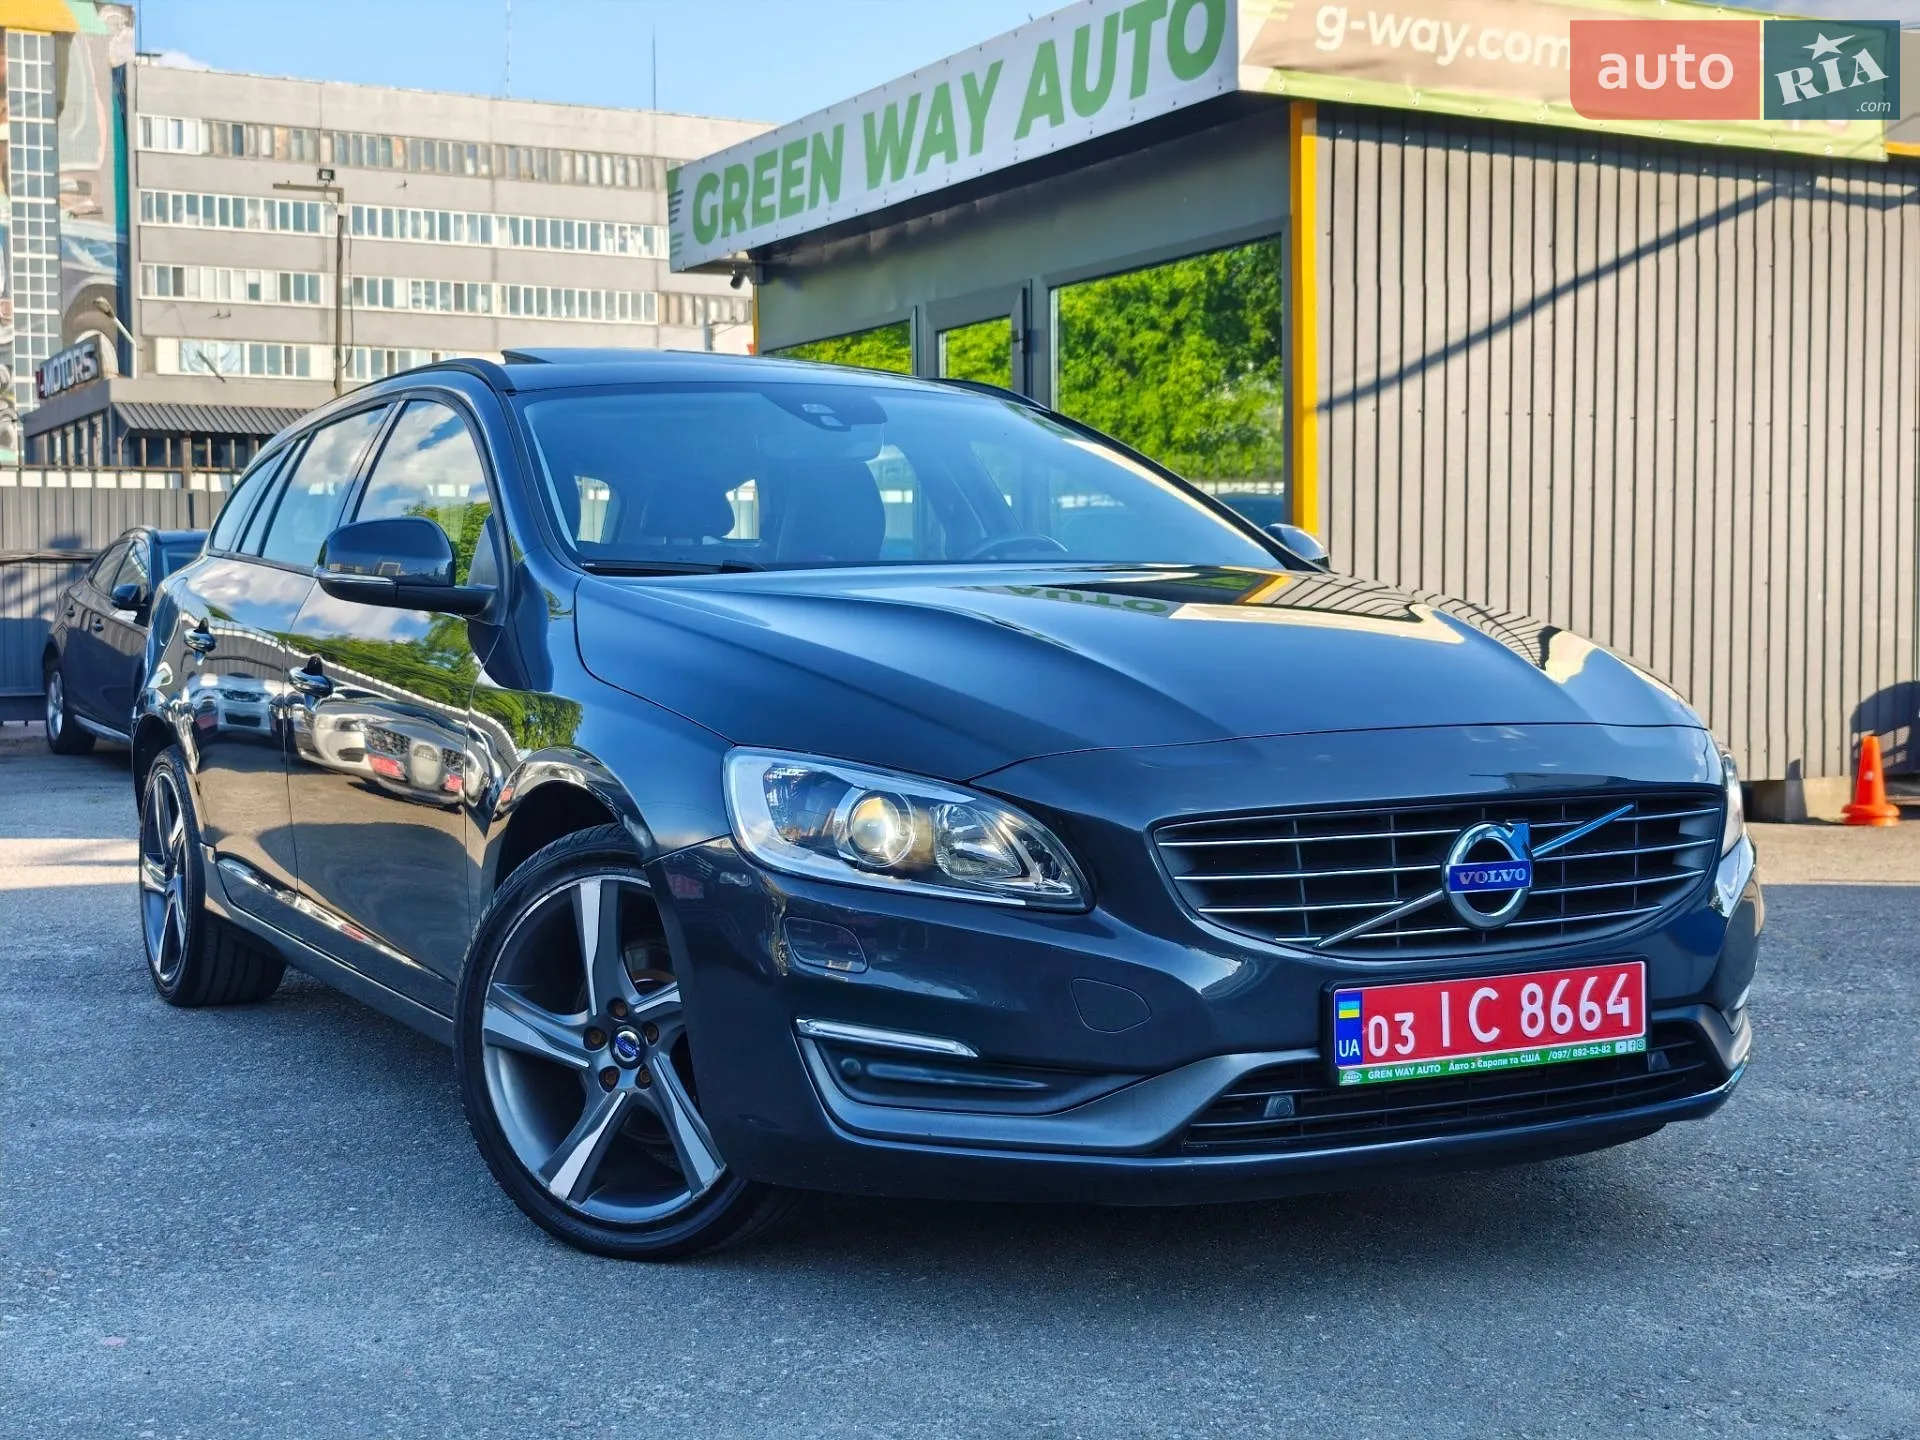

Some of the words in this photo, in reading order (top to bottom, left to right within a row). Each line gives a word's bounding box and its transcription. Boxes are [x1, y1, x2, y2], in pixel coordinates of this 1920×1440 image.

[692, 124, 845, 246] GREEN
[862, 59, 1003, 191] WAY
[1014, 0, 1227, 141] AUTO
[1457, 868, 1527, 885] VOLVO
[1367, 1012, 1415, 1057] 03
[1520, 973, 1630, 1038] 8664
[1338, 1039, 1361, 1058] UA
[1448, 1061, 1469, 1071] Авто
[1520, 1053, 1541, 1063] США
[1367, 1069, 1392, 1080] GREN
[1394, 1066, 1415, 1078] WAY
[1416, 1064, 1441, 1075] AUTO
